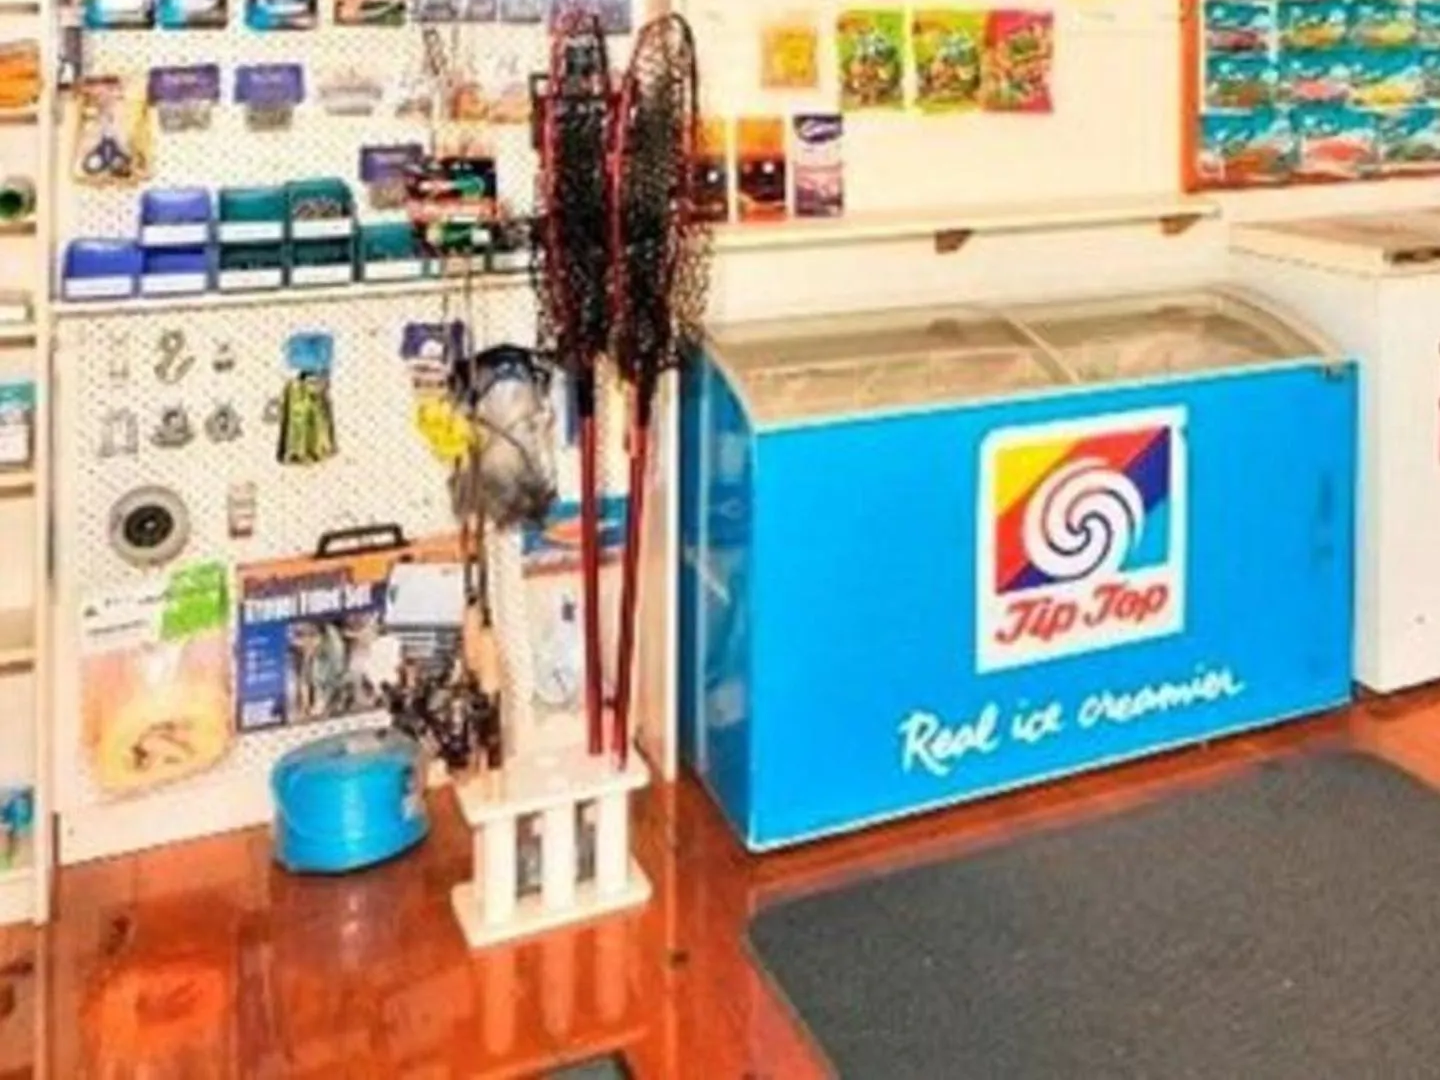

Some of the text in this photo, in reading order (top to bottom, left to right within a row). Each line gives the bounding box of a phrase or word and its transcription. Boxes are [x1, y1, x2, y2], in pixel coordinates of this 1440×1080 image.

[994, 581, 1169, 646] Tip Top
[900, 702, 1000, 776] Real
[1010, 699, 1065, 743] ice
